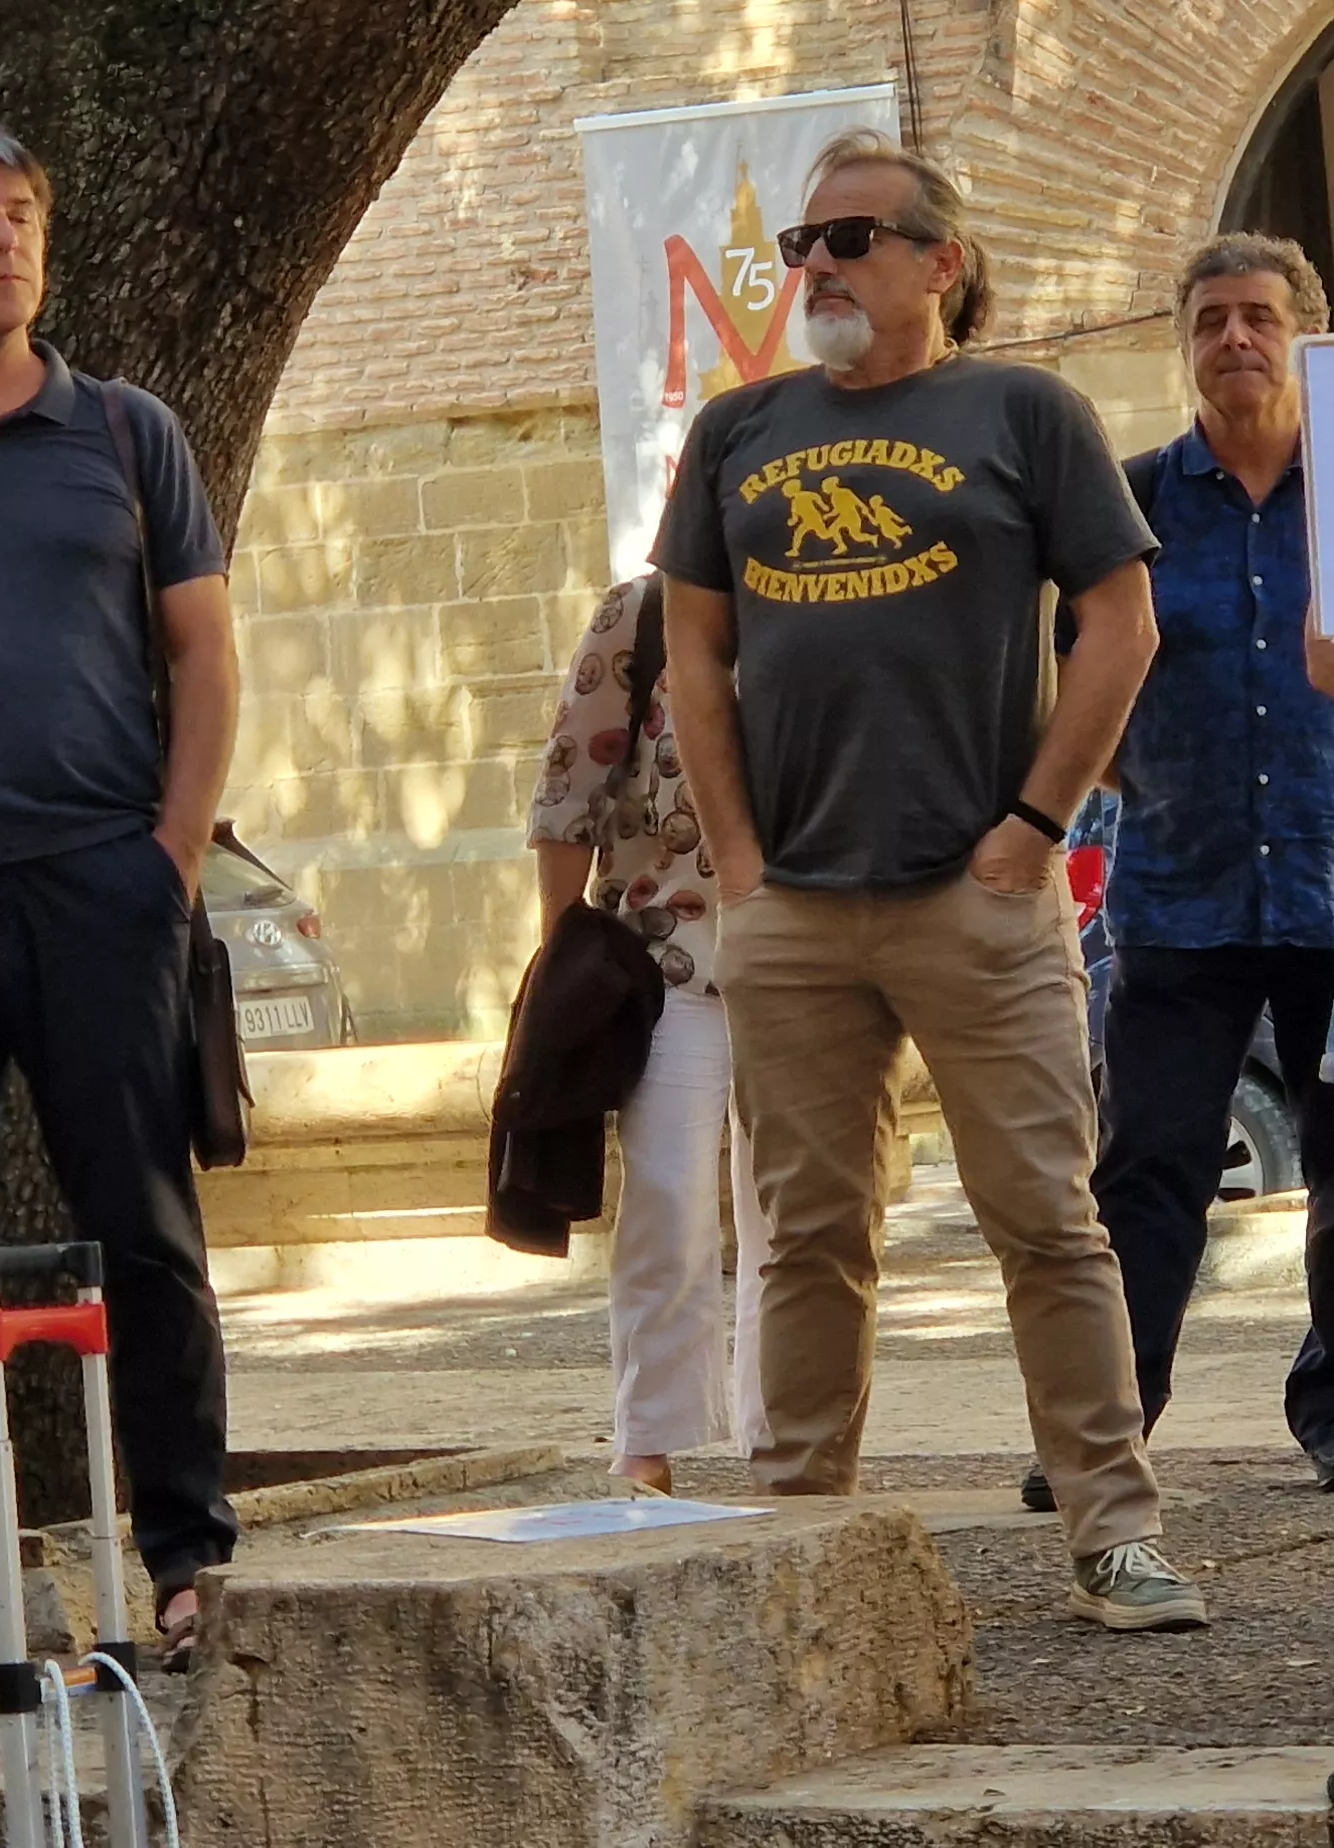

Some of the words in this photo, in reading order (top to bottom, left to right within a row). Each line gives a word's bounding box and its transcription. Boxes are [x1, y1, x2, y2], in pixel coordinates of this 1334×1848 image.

[725, 247, 776, 311] 75
[739, 438, 966, 505] REFUGIADXS
[743, 541, 959, 604] BIENVENIDXS
[244, 1005, 282, 1033] 9311
